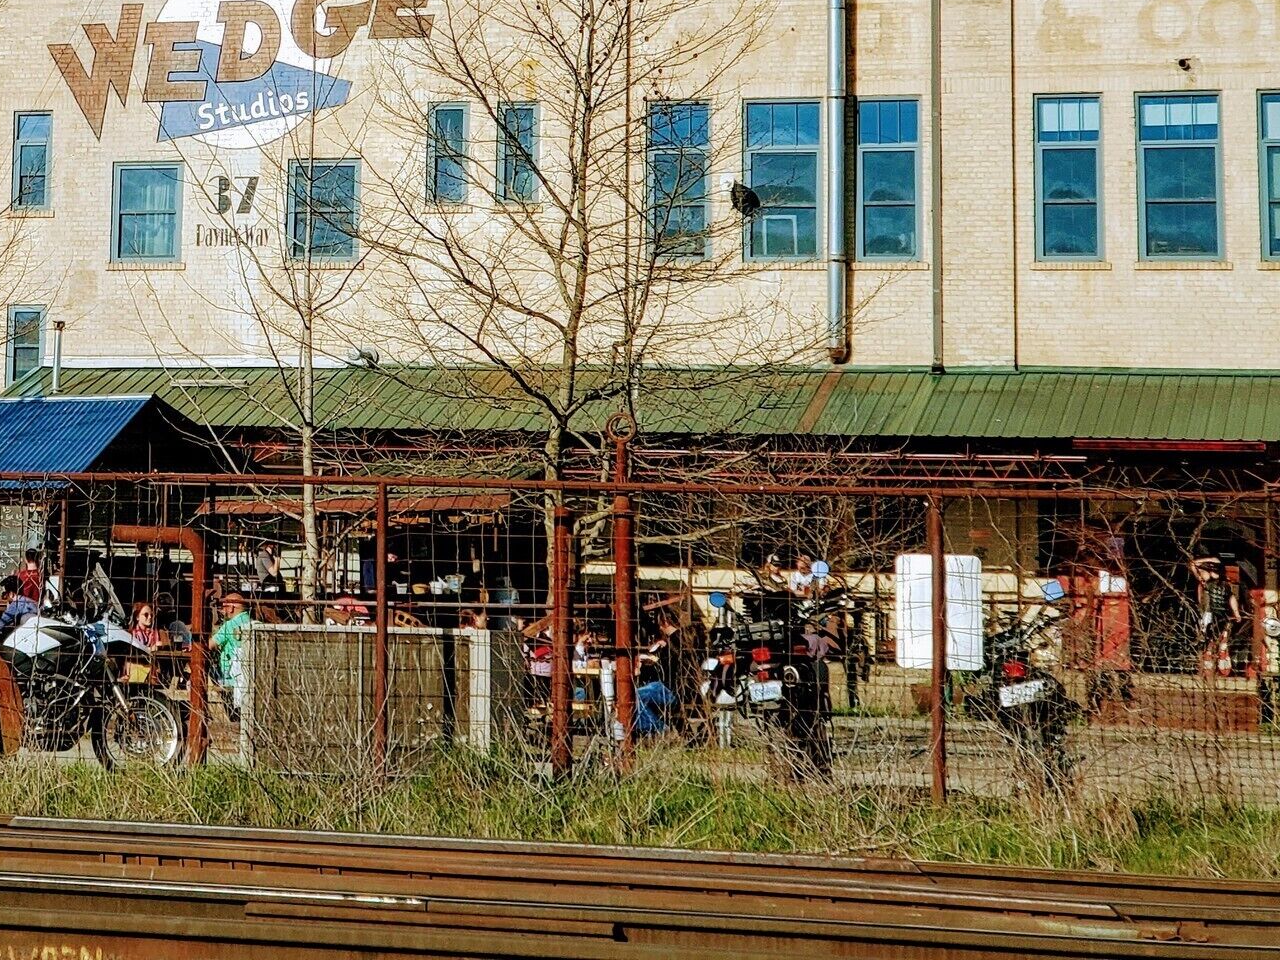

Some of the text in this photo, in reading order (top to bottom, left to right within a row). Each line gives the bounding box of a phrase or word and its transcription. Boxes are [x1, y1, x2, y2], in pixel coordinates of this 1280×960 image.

[197, 88, 310, 130] Studios
[206, 175, 259, 215] 37
[244, 223, 272, 247] Way
